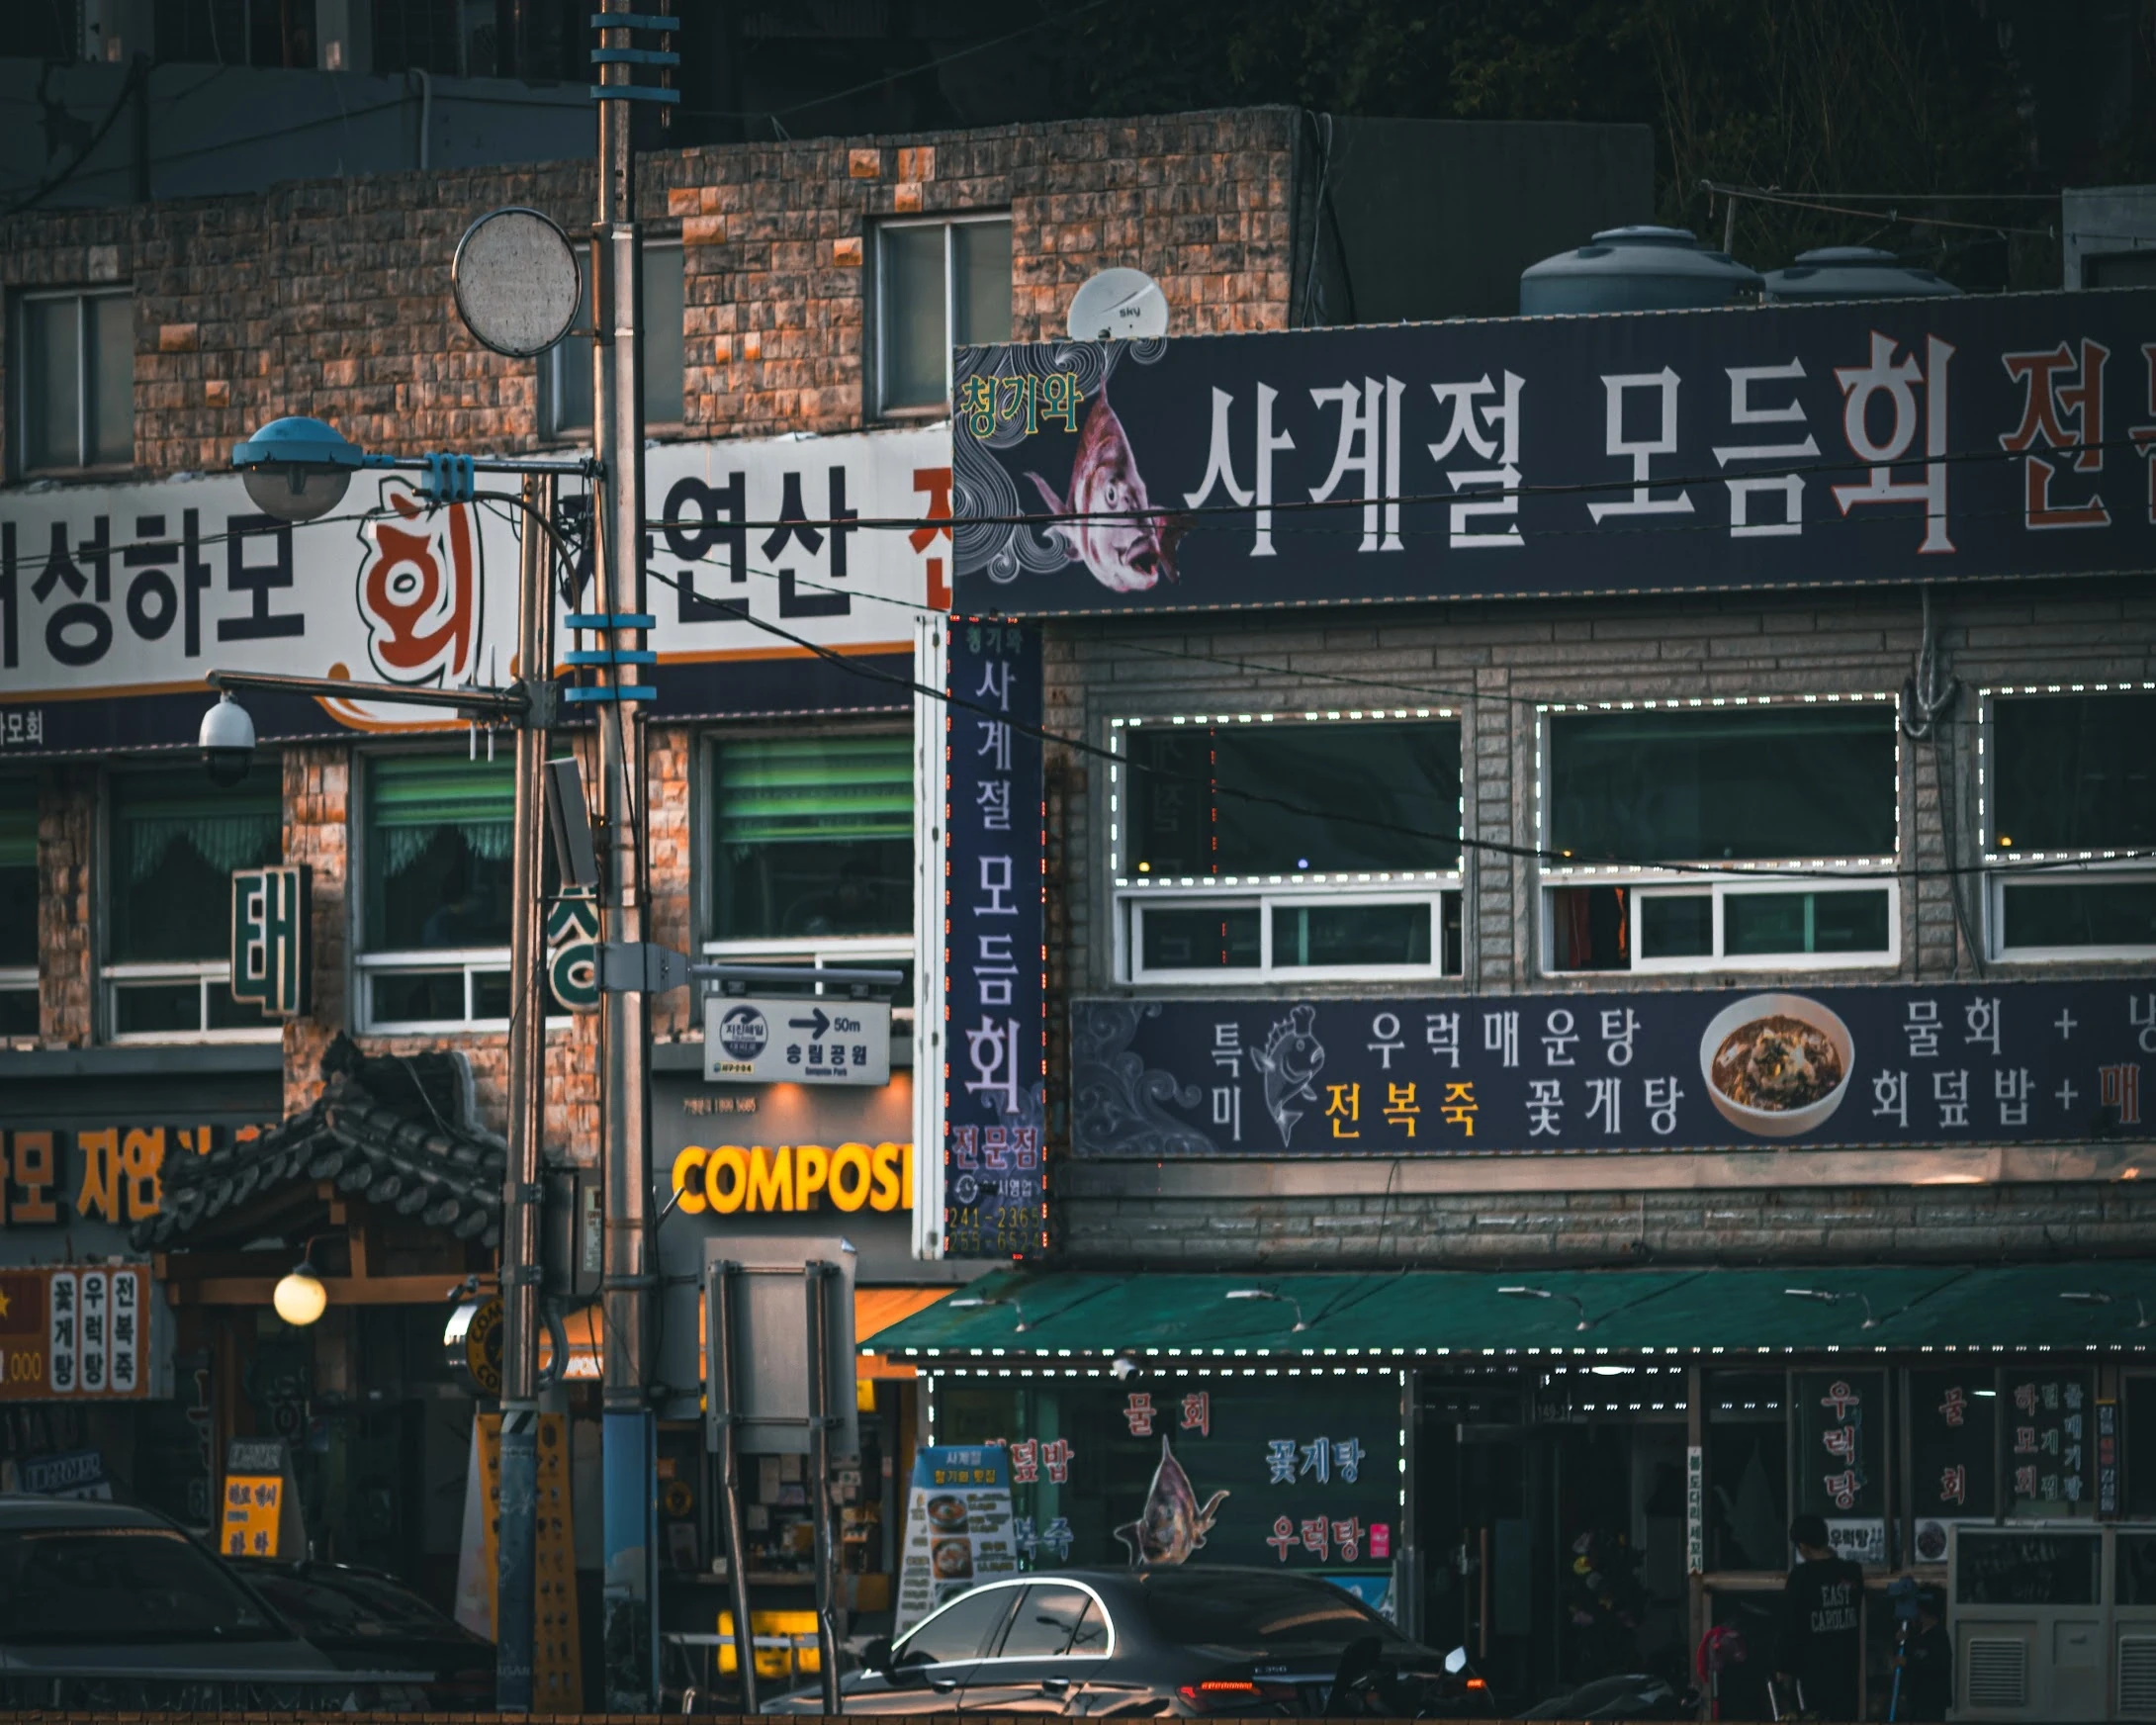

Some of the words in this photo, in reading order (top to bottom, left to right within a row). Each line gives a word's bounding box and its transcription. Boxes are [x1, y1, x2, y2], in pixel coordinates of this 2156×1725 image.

[960, 372, 1084, 438] 청기와
[1183, 368, 1526, 557] 사계절
[1586, 329, 1957, 554] 모듬회
[1999, 336, 2156, 530] 전
[0, 507, 305, 669] 성하모
[975, 659, 1018, 831] 사계절
[964, 854, 1022, 1115] 모듬회
[786, 1044, 867, 1066] 송림공원
[834, 1018, 861, 1033] 50m
[1366, 1006, 1642, 1070] 우럭매운탕
[1903, 995, 2003, 1057] 물회
[1324, 1080, 1481, 1139] 전복죽
[1524, 1076, 1685, 1136] 꽃게탕
[1872, 1068, 2036, 1129] 회덮밥
[951, 1124, 1039, 1170] 전문점
[1123, 1391, 1211, 1438] 물회
[985, 1438, 1075, 1484] 덮밥
[1266, 1436, 1367, 1485] 꽃게탕
[1266, 1514, 1367, 1563] 우럭탕
